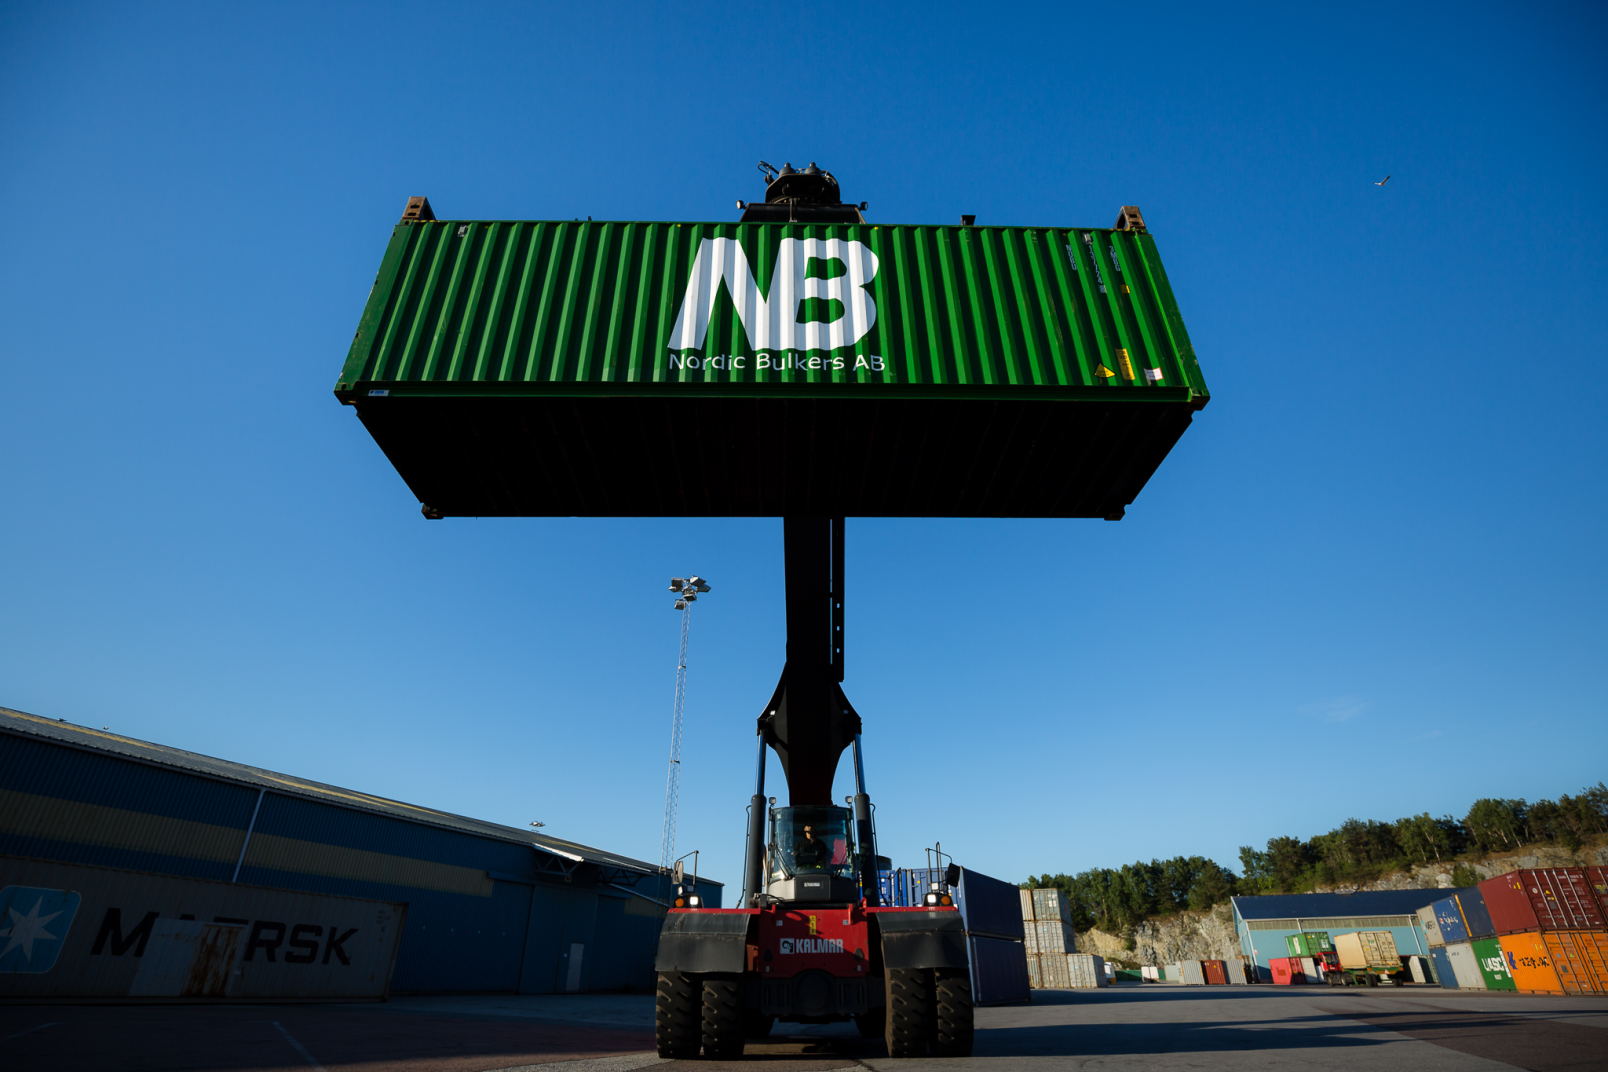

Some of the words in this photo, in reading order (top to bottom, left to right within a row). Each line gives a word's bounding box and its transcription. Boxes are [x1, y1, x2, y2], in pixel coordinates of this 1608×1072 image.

[667, 236, 880, 352] NB
[669, 352, 747, 372] Nordic
[756, 352, 846, 373] Bulkers
[852, 353, 886, 373] AB
[89, 906, 360, 967] MRSK
[796, 939, 844, 953] KALMAR
